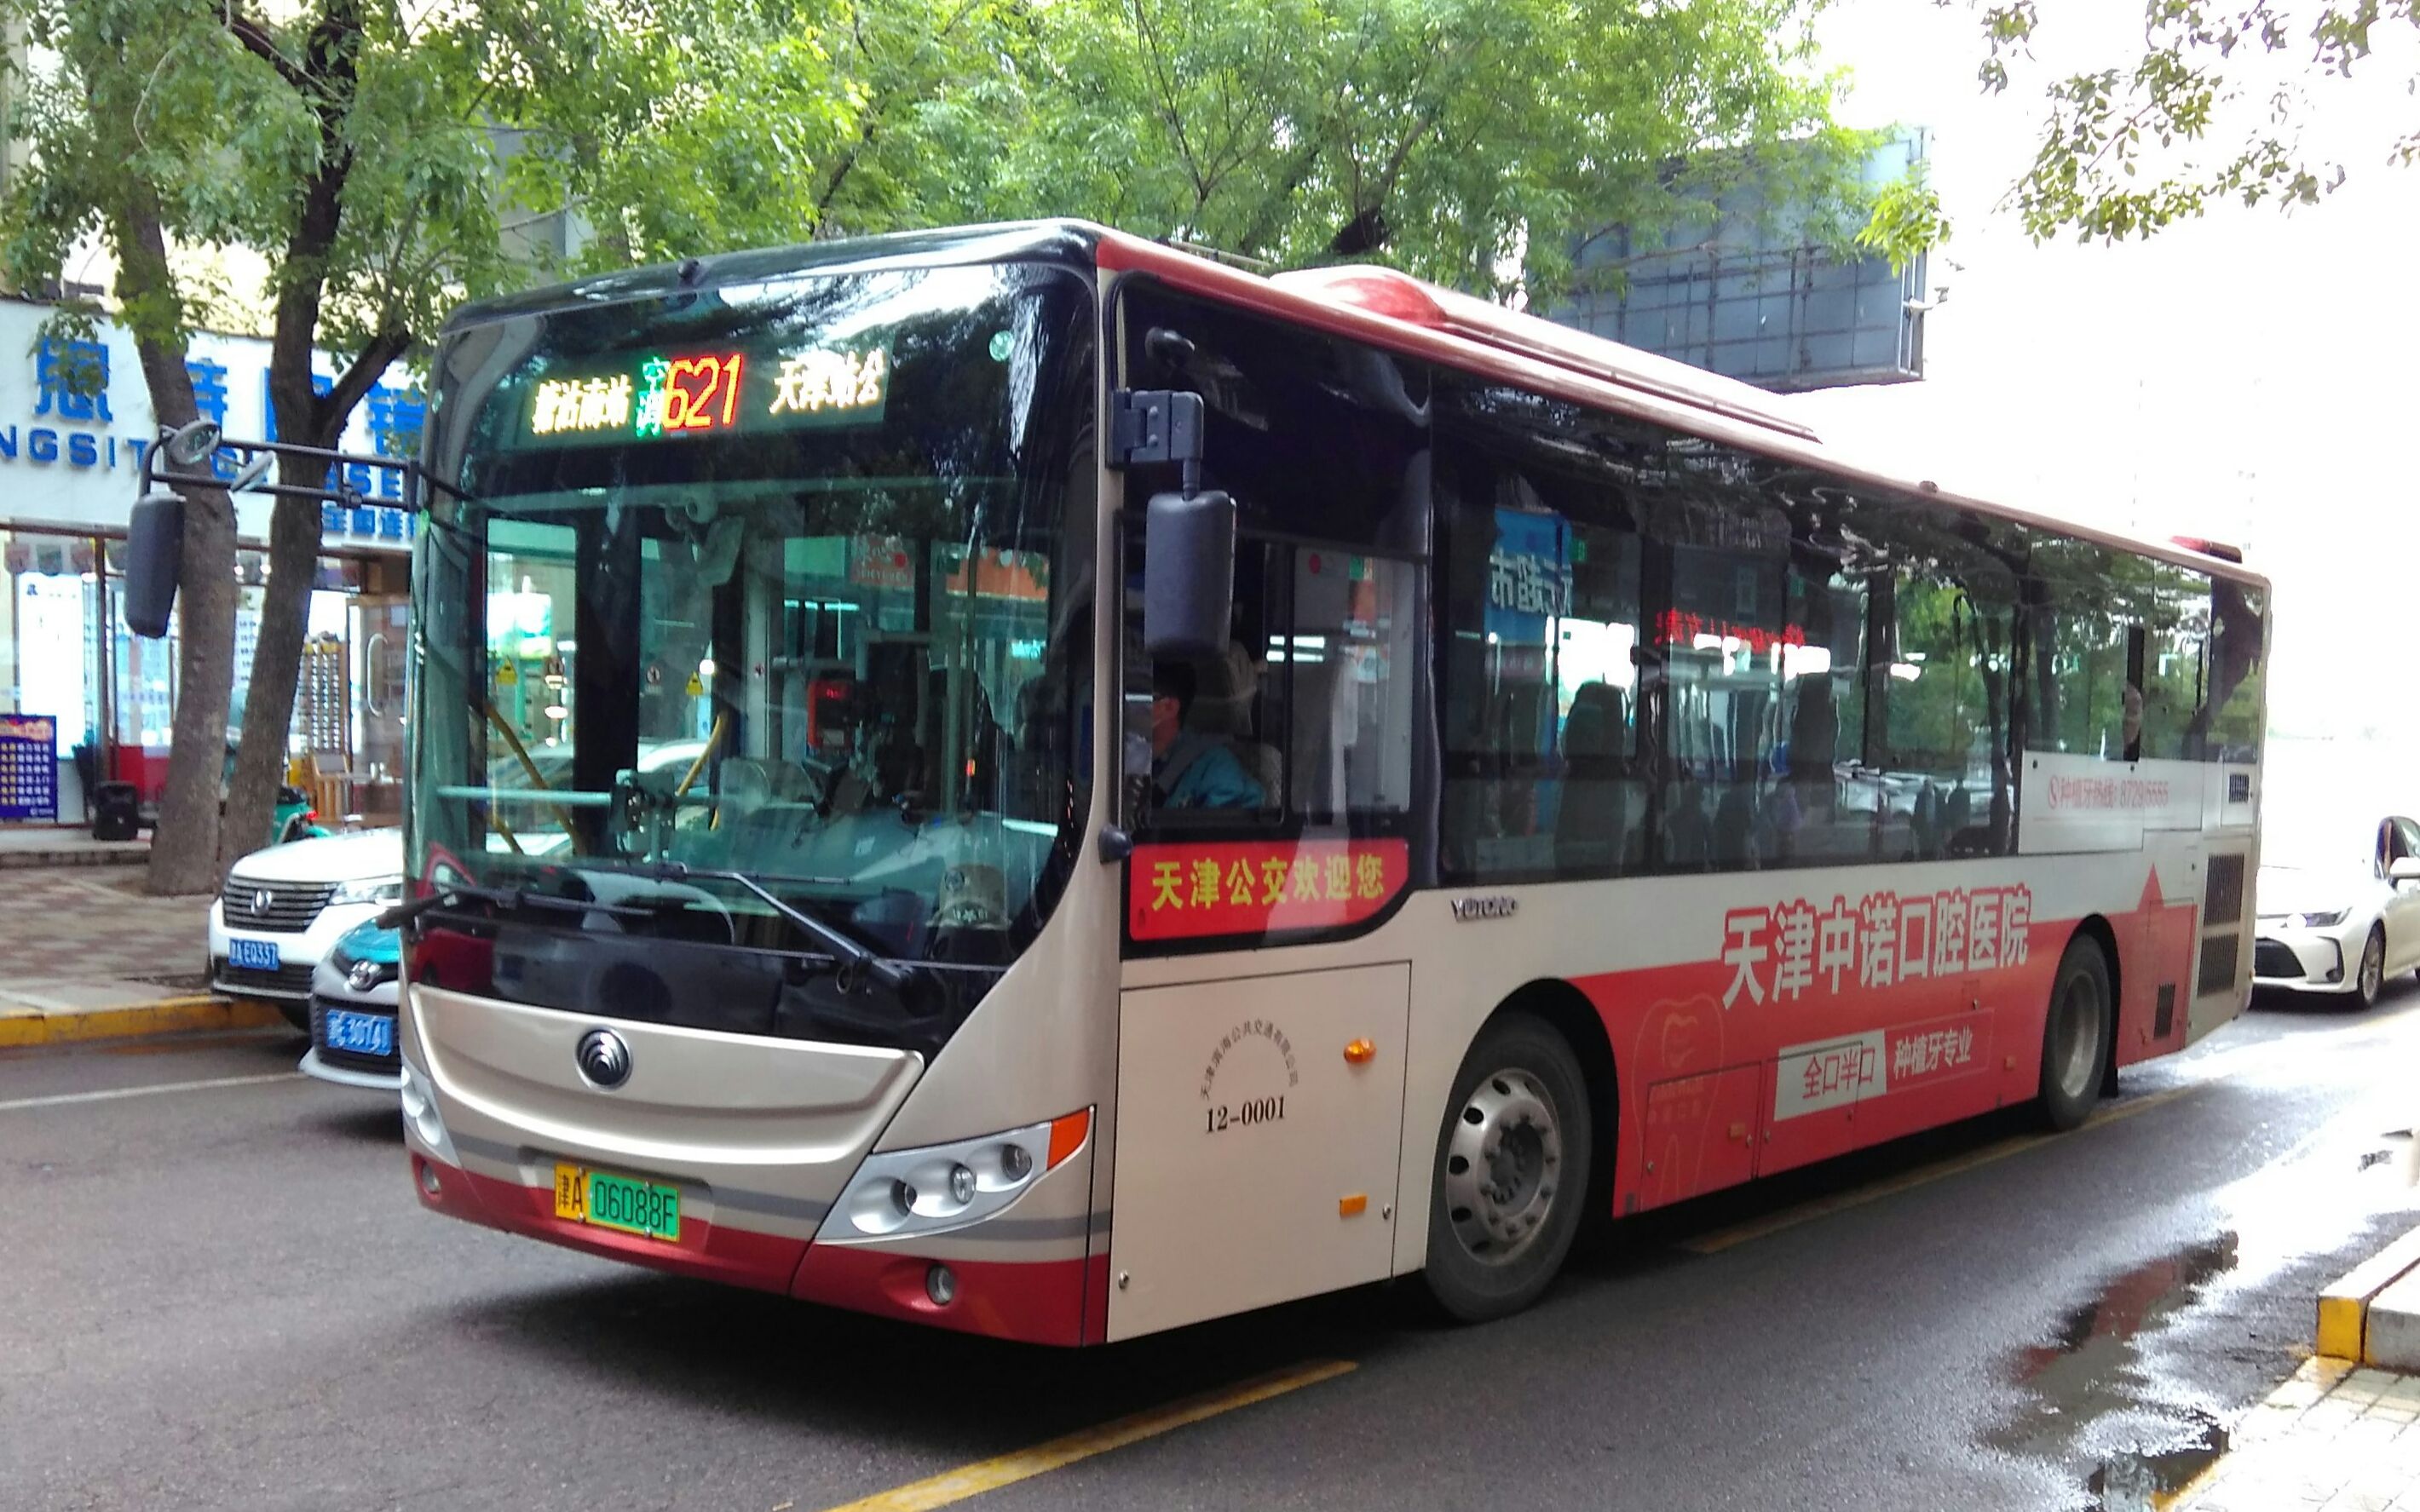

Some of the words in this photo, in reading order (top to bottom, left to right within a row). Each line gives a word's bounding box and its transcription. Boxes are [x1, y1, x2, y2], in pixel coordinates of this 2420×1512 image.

[663, 353, 743, 430] 621
[322, 504, 417, 541] 全国连
[1152, 854, 1386, 911] 天津公交欢迎您
[1722, 884, 2031, 1010] 天津中诺口腔医院
[1802, 1046, 1876, 1100] 全口半口
[1893, 1026, 1973, 1081] 种植牙专业
[1207, 1095, 1285, 1133] 12-0001
